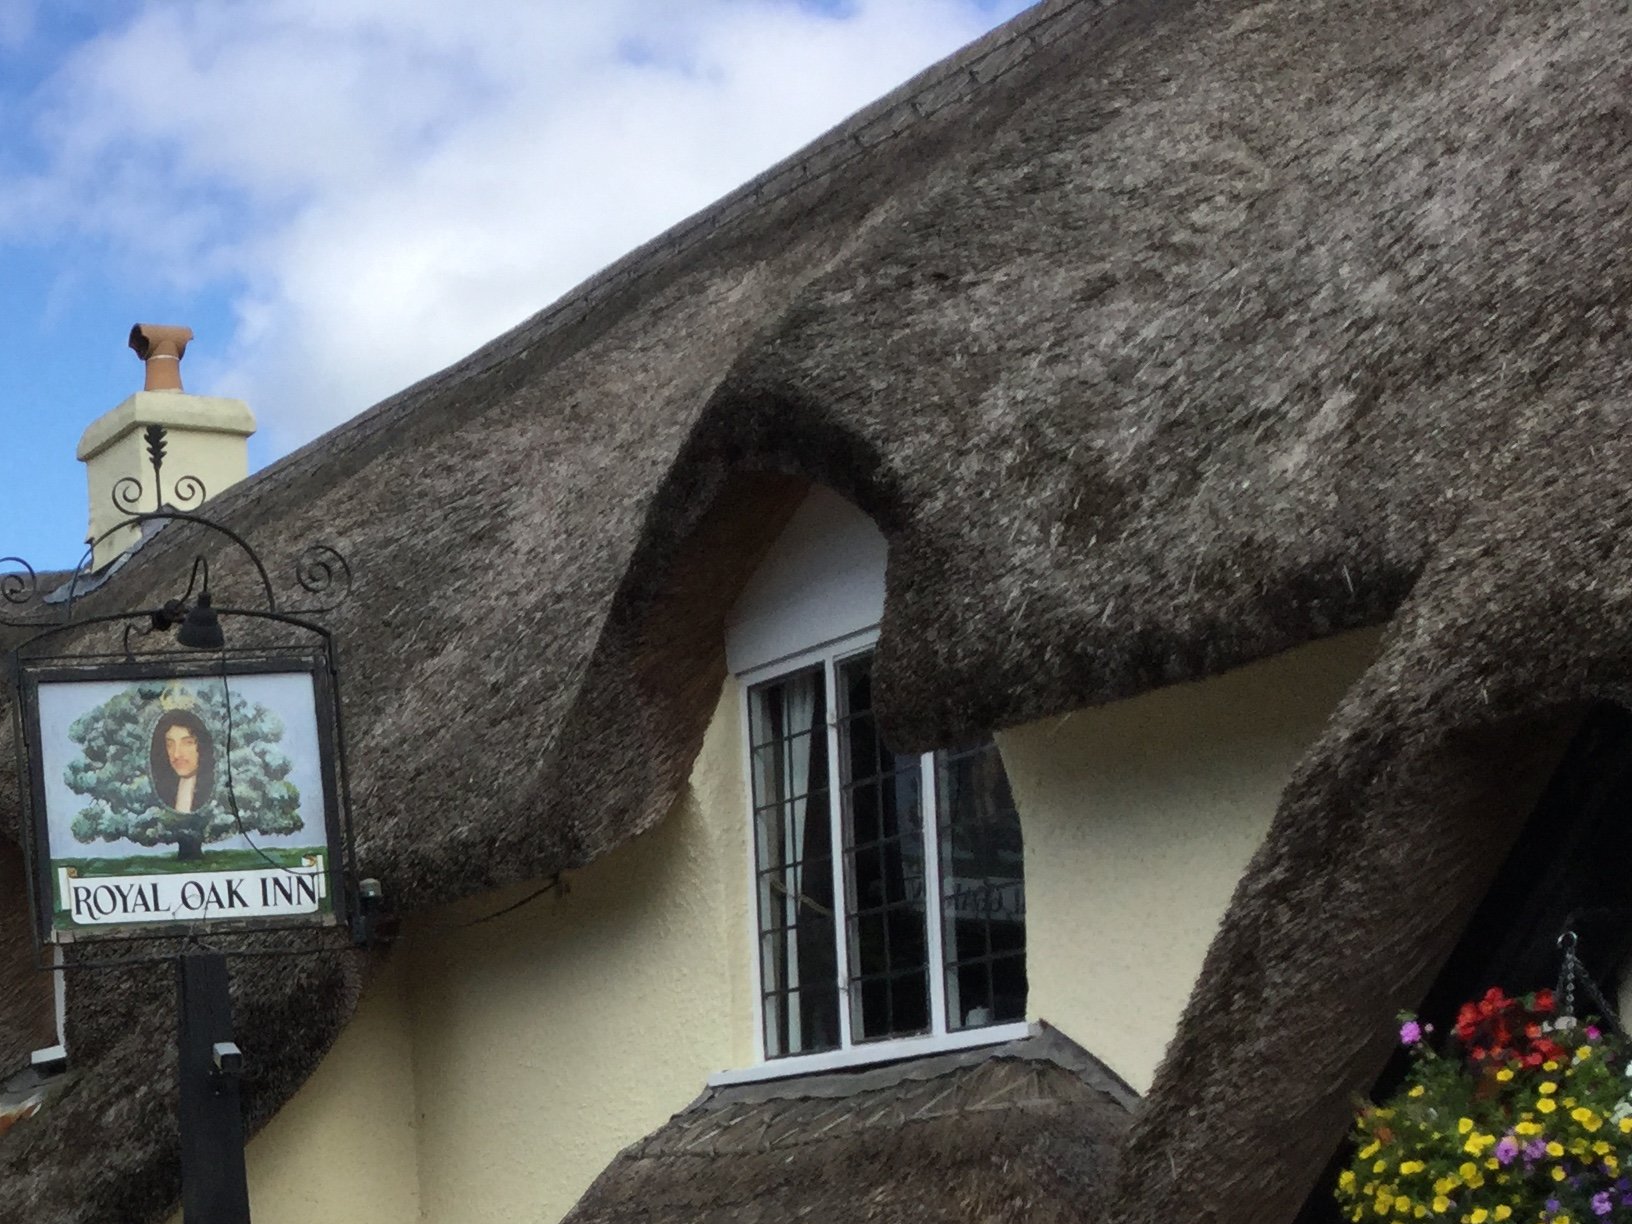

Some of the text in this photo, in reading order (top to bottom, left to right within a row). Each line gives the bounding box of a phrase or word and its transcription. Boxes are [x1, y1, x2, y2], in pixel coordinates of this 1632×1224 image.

[73, 873, 317, 920] ROYAL OAK INN
